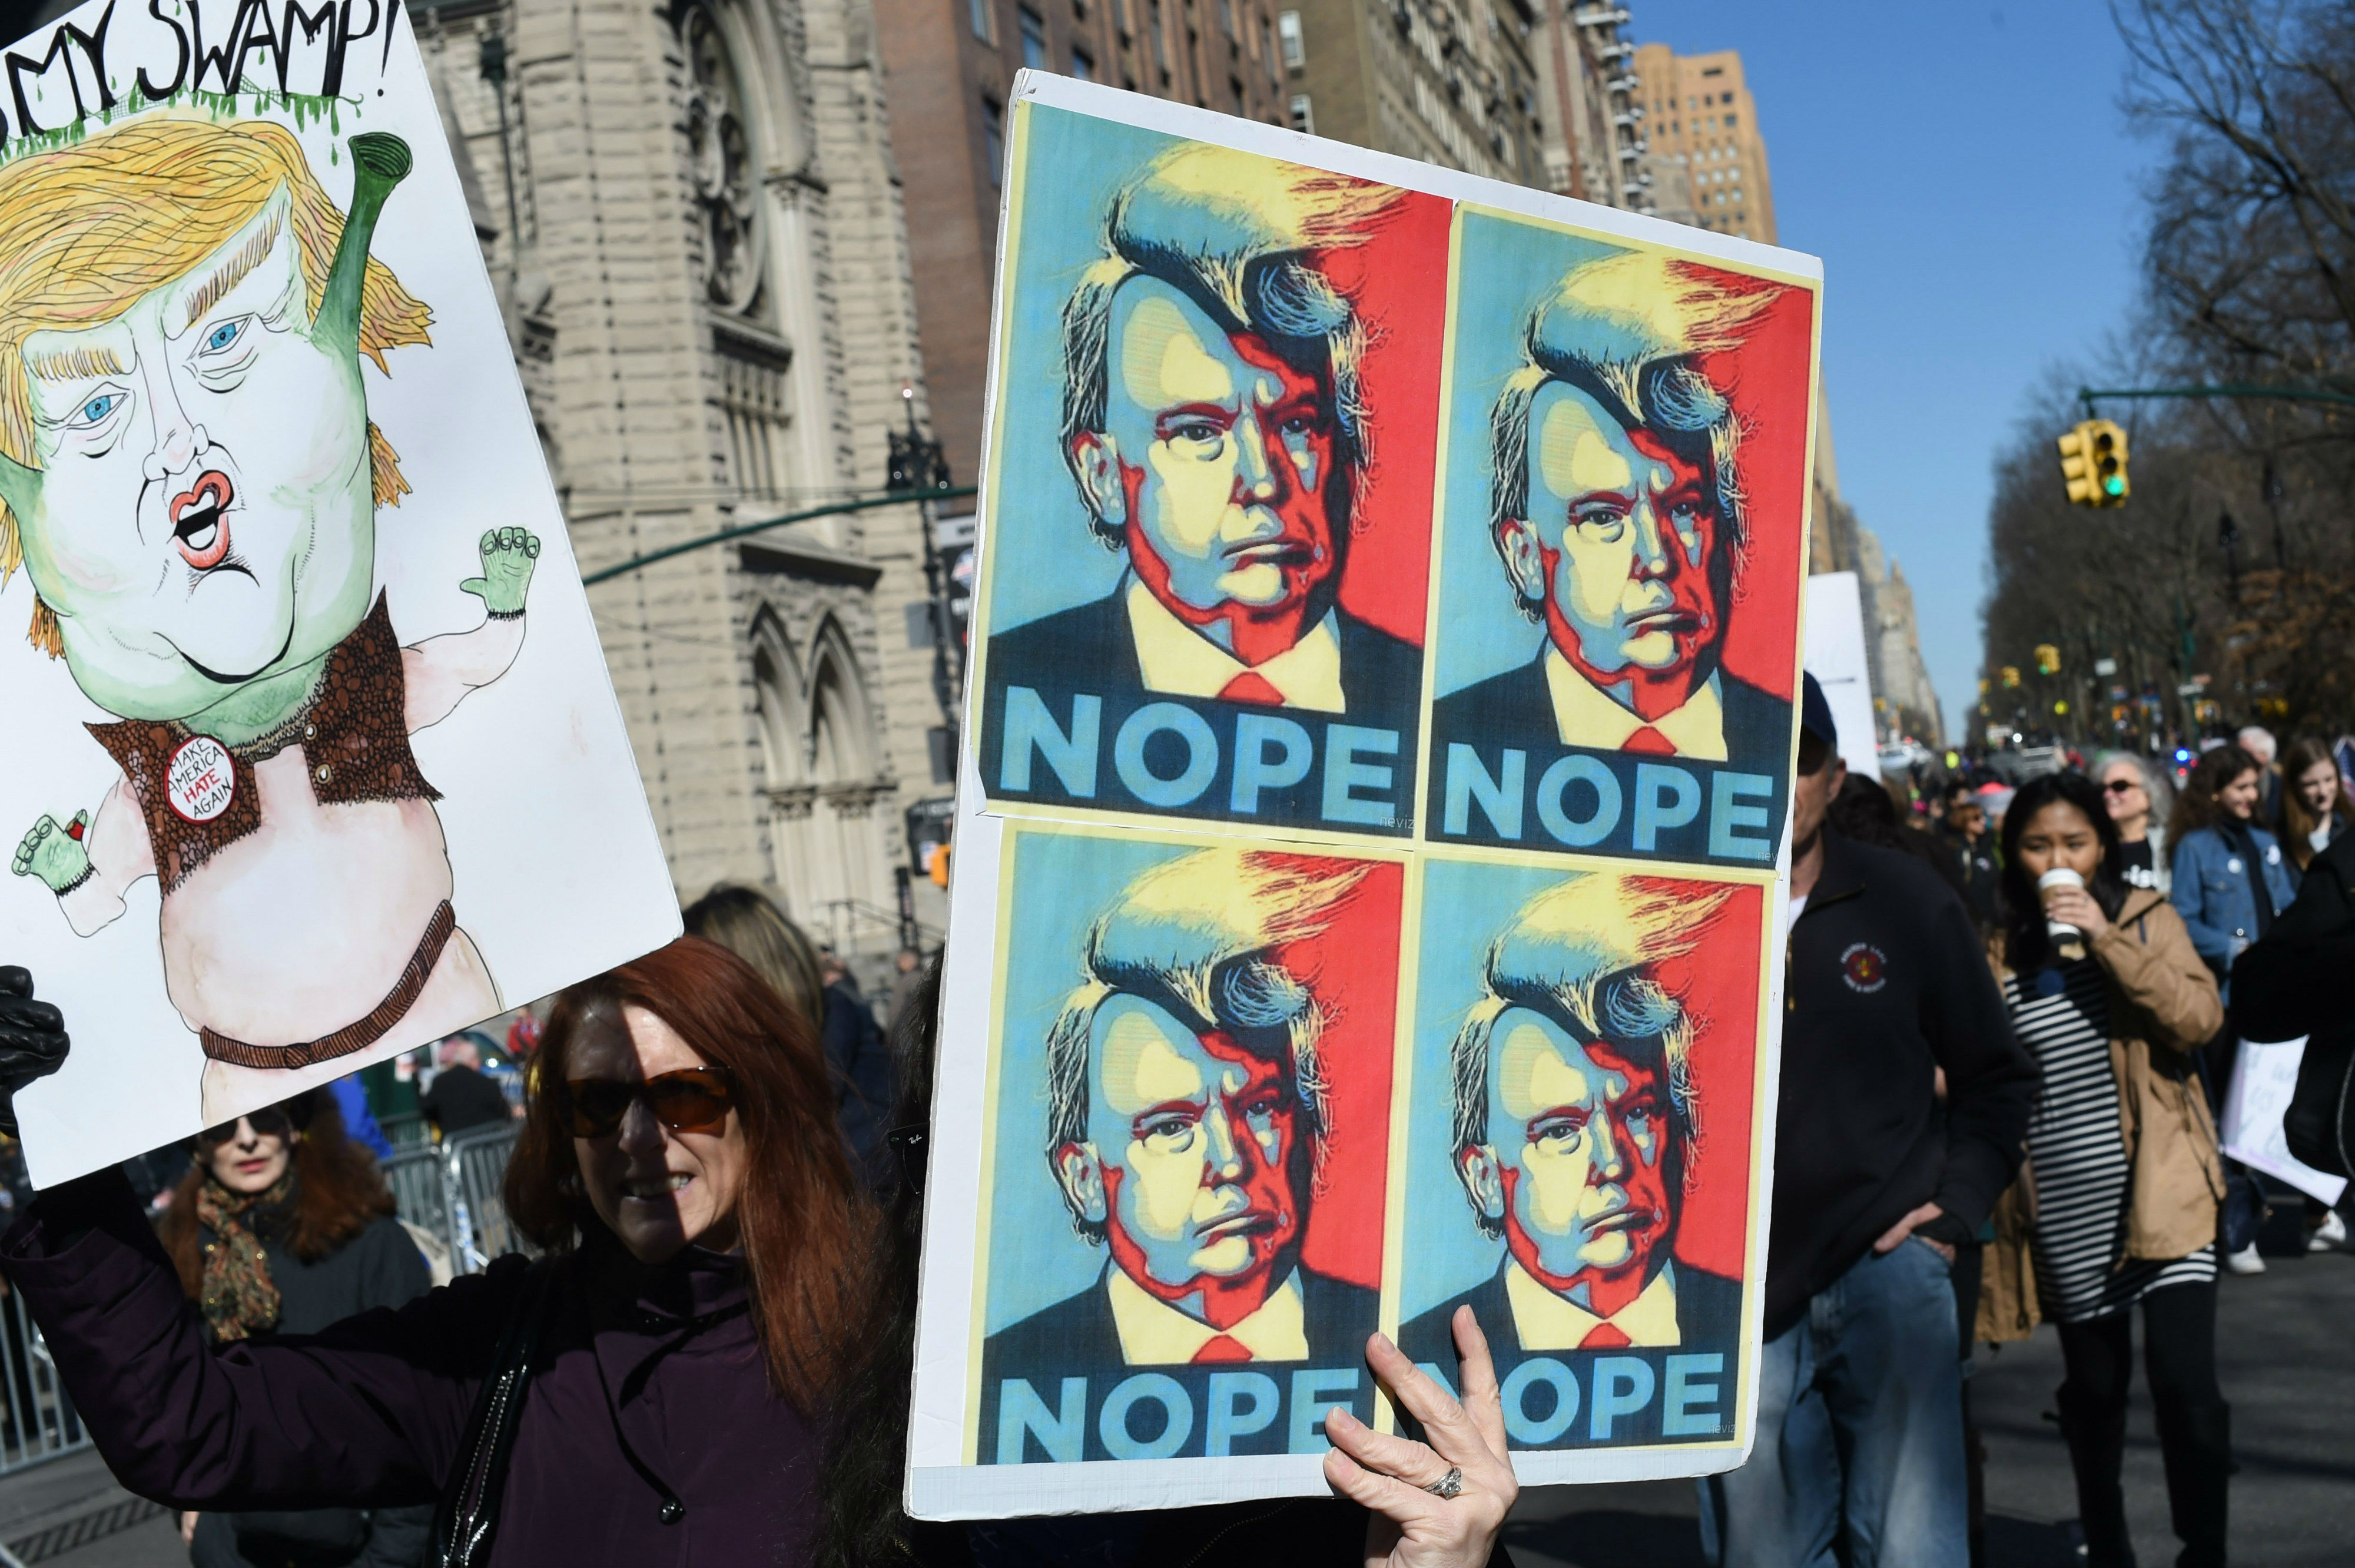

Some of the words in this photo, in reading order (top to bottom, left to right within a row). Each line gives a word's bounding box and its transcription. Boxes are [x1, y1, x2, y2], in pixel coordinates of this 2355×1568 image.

[5, 0, 116, 137] MY
[137, 0, 400, 101] SWAMP!
[168, 746, 224, 793] AMERICA
[169, 737, 210, 776] MAKE
[184, 768, 220, 804] HATE
[194, 776, 233, 818] AGAIN
[1000, 685, 1399, 825] NOPE
[1444, 742, 1773, 859] NOPE
[997, 1368, 1359, 1464] NOPE
[1414, 1353, 1723, 1445] OPE
